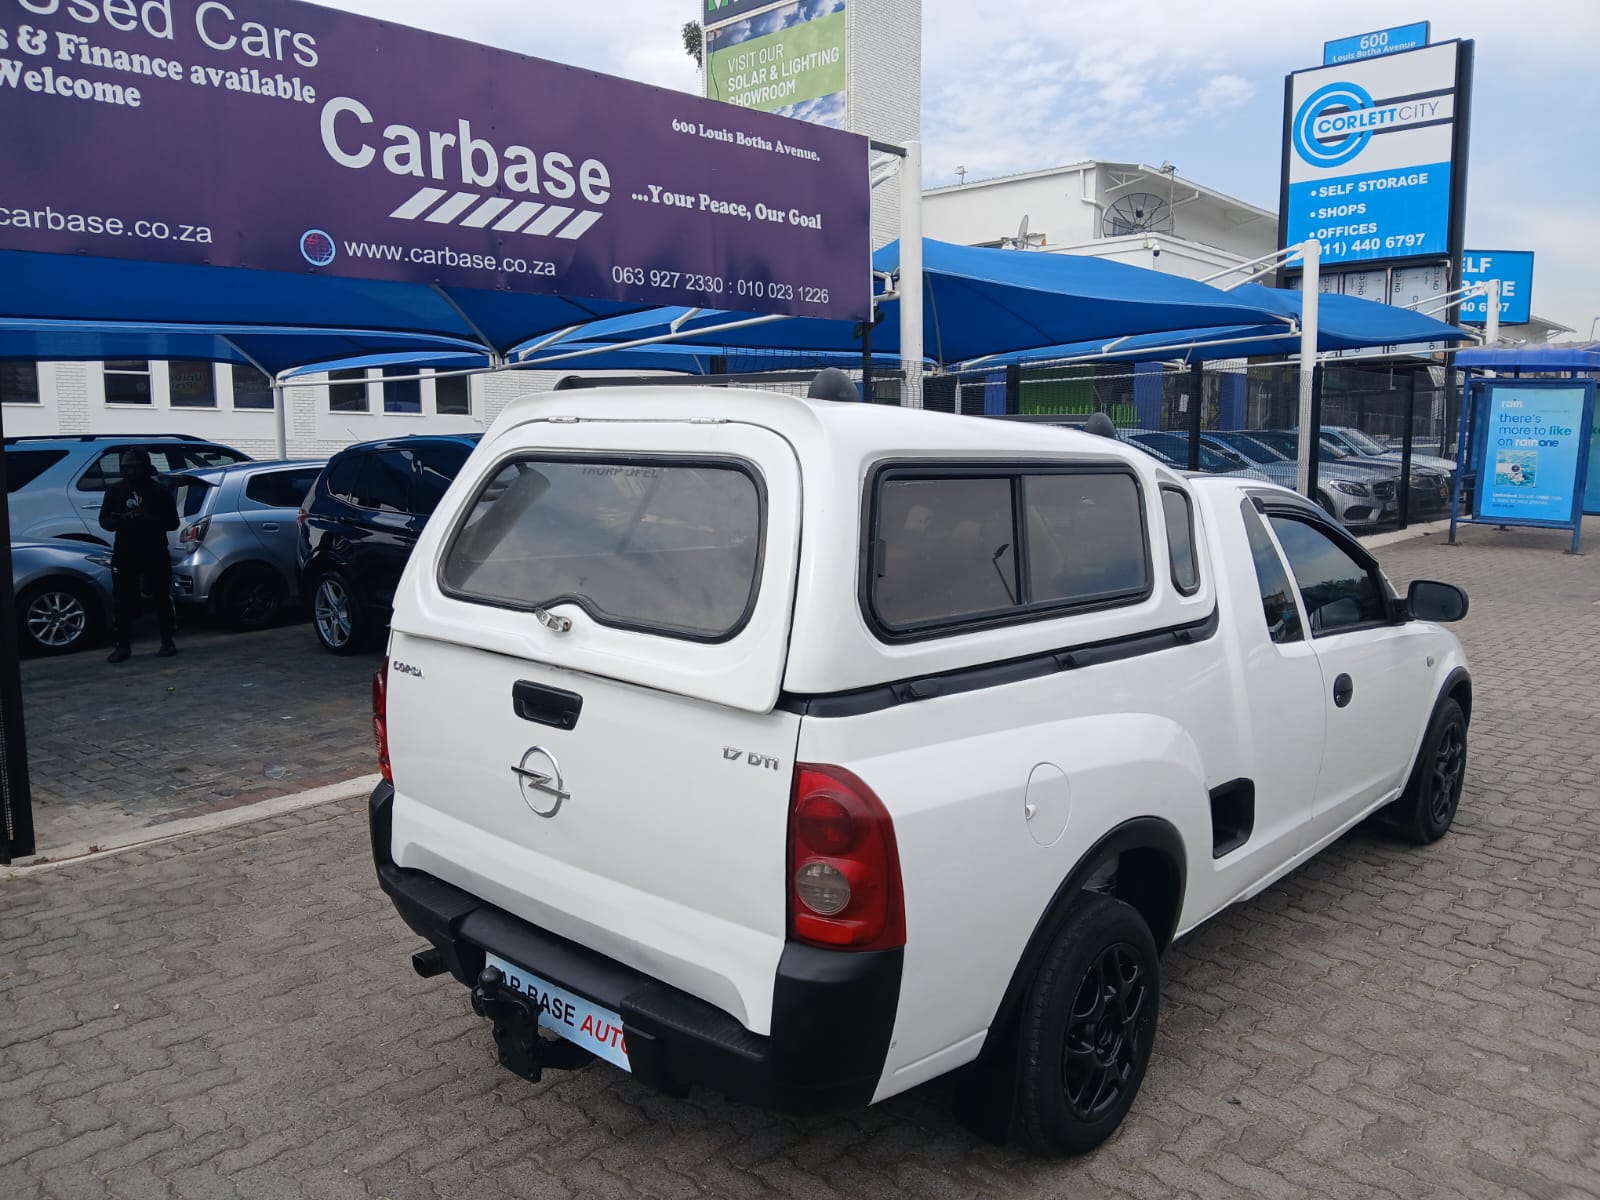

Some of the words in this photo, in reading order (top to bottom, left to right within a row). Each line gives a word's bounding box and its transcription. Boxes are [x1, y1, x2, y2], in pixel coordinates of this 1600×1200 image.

[195, 1, 319, 68] Cars
[1360, 32, 1389, 49] 600
[17, 24, 47, 56] &
[55, 31, 184, 81] Finance
[190, 66, 316, 103] available
[728, 51, 756, 73] VISIT
[759, 43, 784, 64] OUR
[1333, 52, 1355, 63] Louis
[1357, 47, 1382, 58] Botha
[1383, 40, 1416, 53] Avenue
[0, 58, 141, 107] Welcome
[728, 68, 767, 92] SOLAR
[769, 65, 778, 80] &
[781, 46, 840, 78] LIGHTING
[320, 96, 611, 205] Carbase
[672, 118, 696, 134] 600
[699, 123, 734, 143] Louis
[736, 131, 773, 151] Botha
[775, 139, 821, 162] Avenue.
[1319, 183, 1354, 197] SELF
[1358, 173, 1429, 192] STORAGE
[698, 193, 752, 221] Peace,
[754, 203, 786, 223] Our
[788, 209, 822, 230] Goal
[1318, 203, 1367, 219] SHOPS
[1317, 222, 1378, 239] OFFICES
[1351, 238, 1381, 252] 440
[1385, 233, 1426, 249] 6797
[344, 240, 556, 277] www.carbase.co.za
[612, 265, 645, 286] 063
[650, 269, 680, 289] 927
[685, 274, 724, 294] 2330
[737, 279, 764, 297] 010
[768, 282, 794, 300] 023
[797, 286, 829, 303] 1226
[1501, 398, 1523, 408] rain
[1499, 427, 1531, 435] more
[1534, 426, 1546, 435] to
[1549, 425, 1572, 436] like
[1500, 413, 1542, 424] there's
[1497, 438, 1513, 447] on
[580, 1014, 628, 1054] AUT
